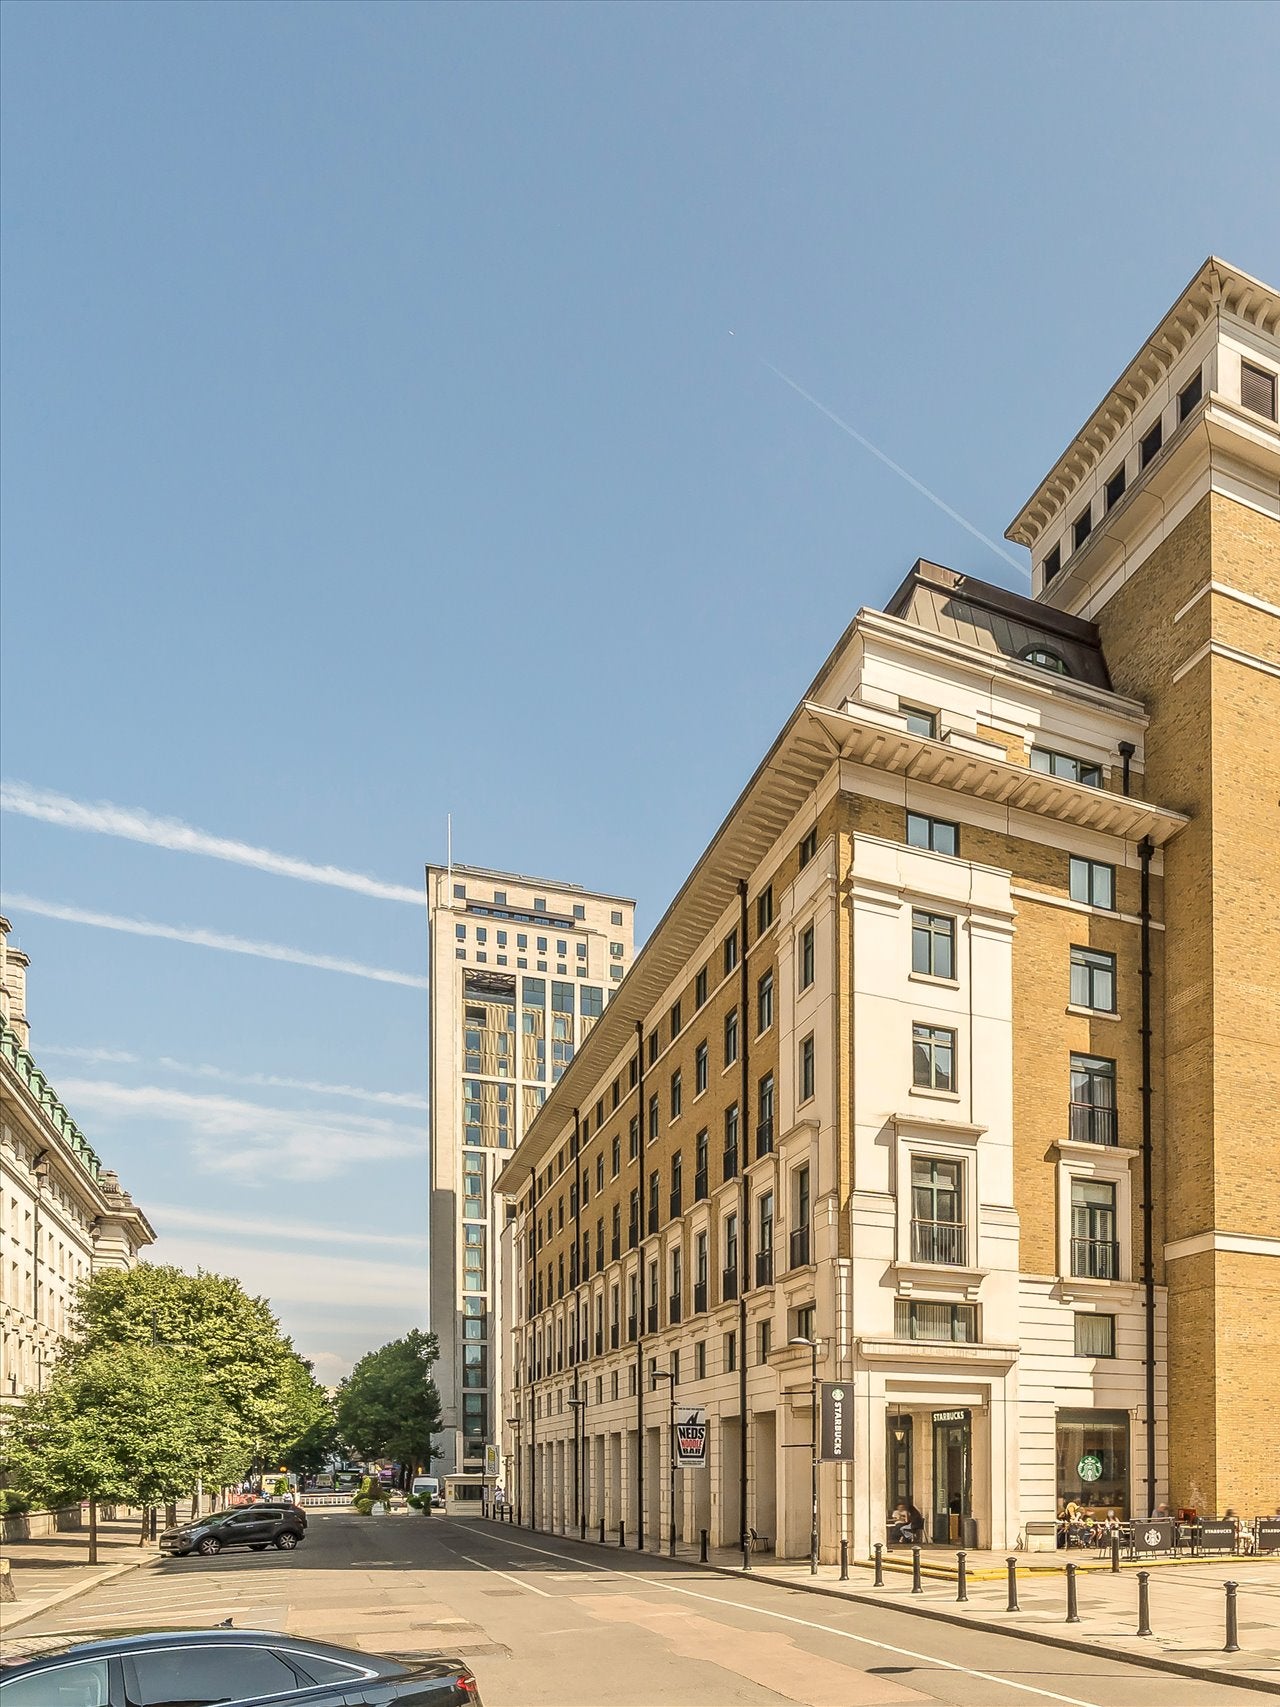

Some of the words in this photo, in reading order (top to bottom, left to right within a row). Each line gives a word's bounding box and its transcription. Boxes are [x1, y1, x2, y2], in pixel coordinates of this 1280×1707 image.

[933, 1411, 964, 1421] STARBUCKS
[678, 1427, 704, 1439] NEDS
[833, 1402, 842, 1455] STARBUCKS
